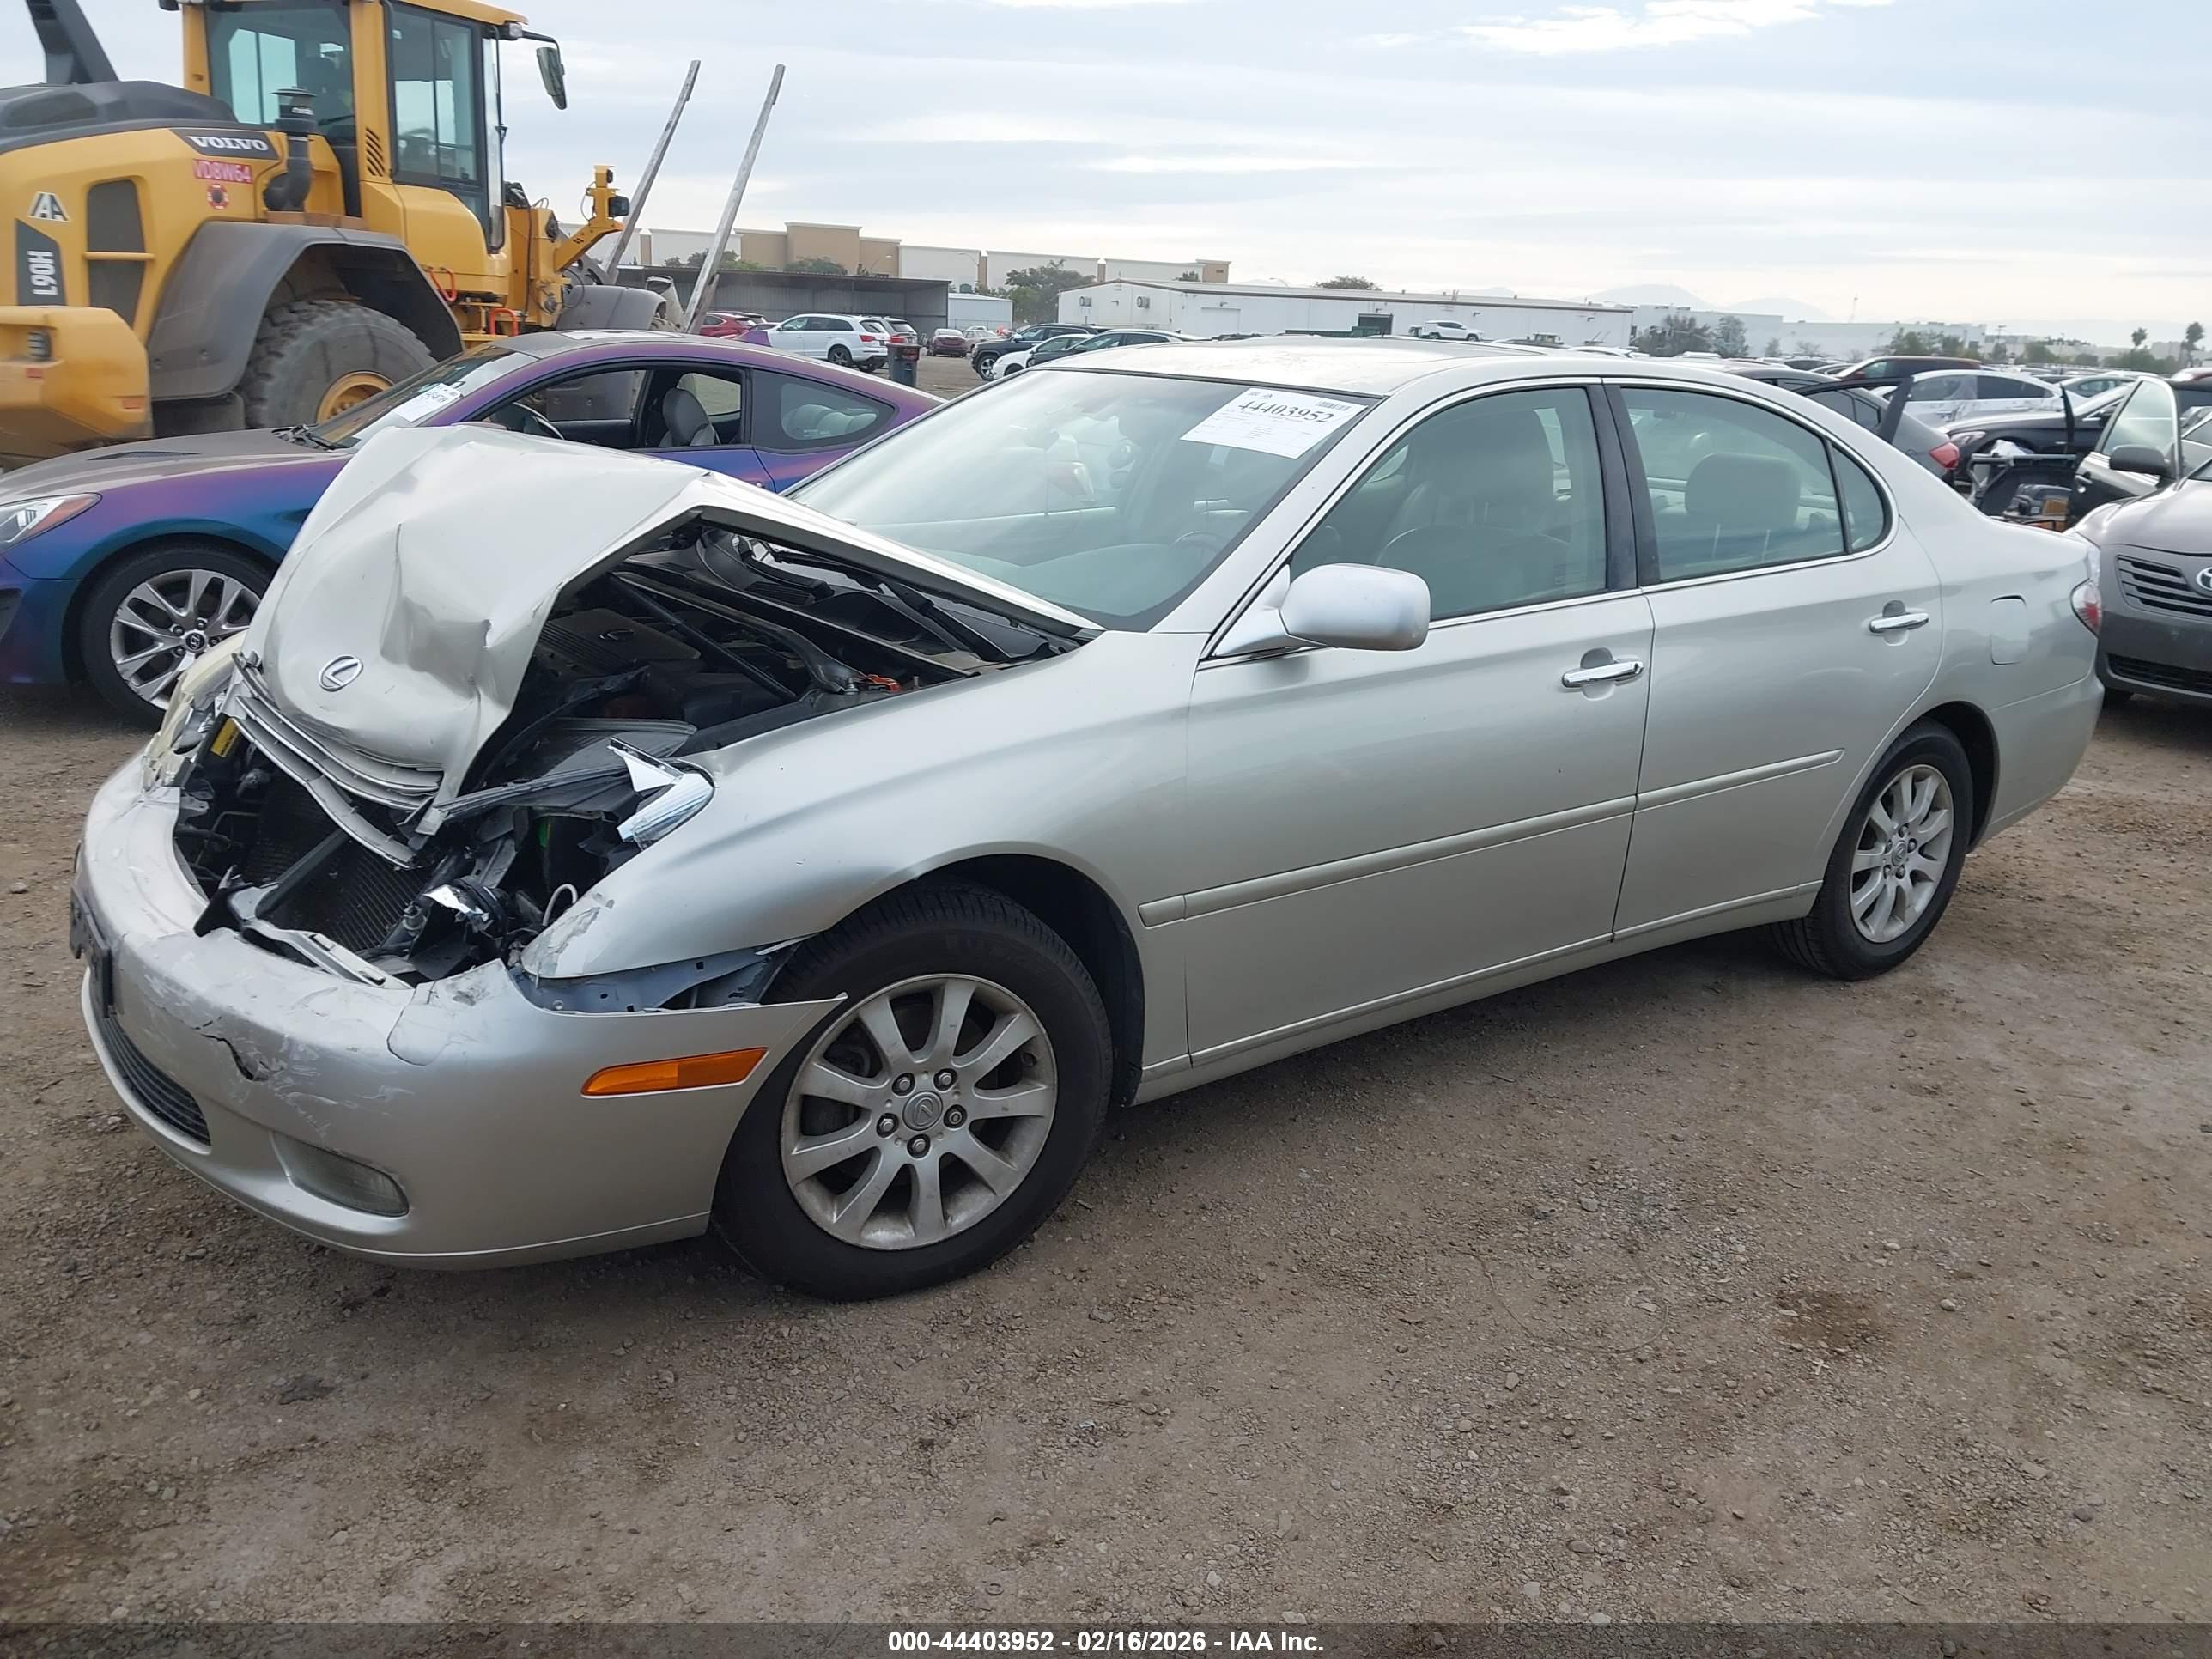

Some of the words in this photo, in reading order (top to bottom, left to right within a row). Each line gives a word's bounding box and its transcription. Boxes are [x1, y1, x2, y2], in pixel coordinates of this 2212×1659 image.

[186, 135, 269, 151] VOLVO
[27, 249, 58, 295] L90H
[1237, 399, 1334, 423] 44403952
